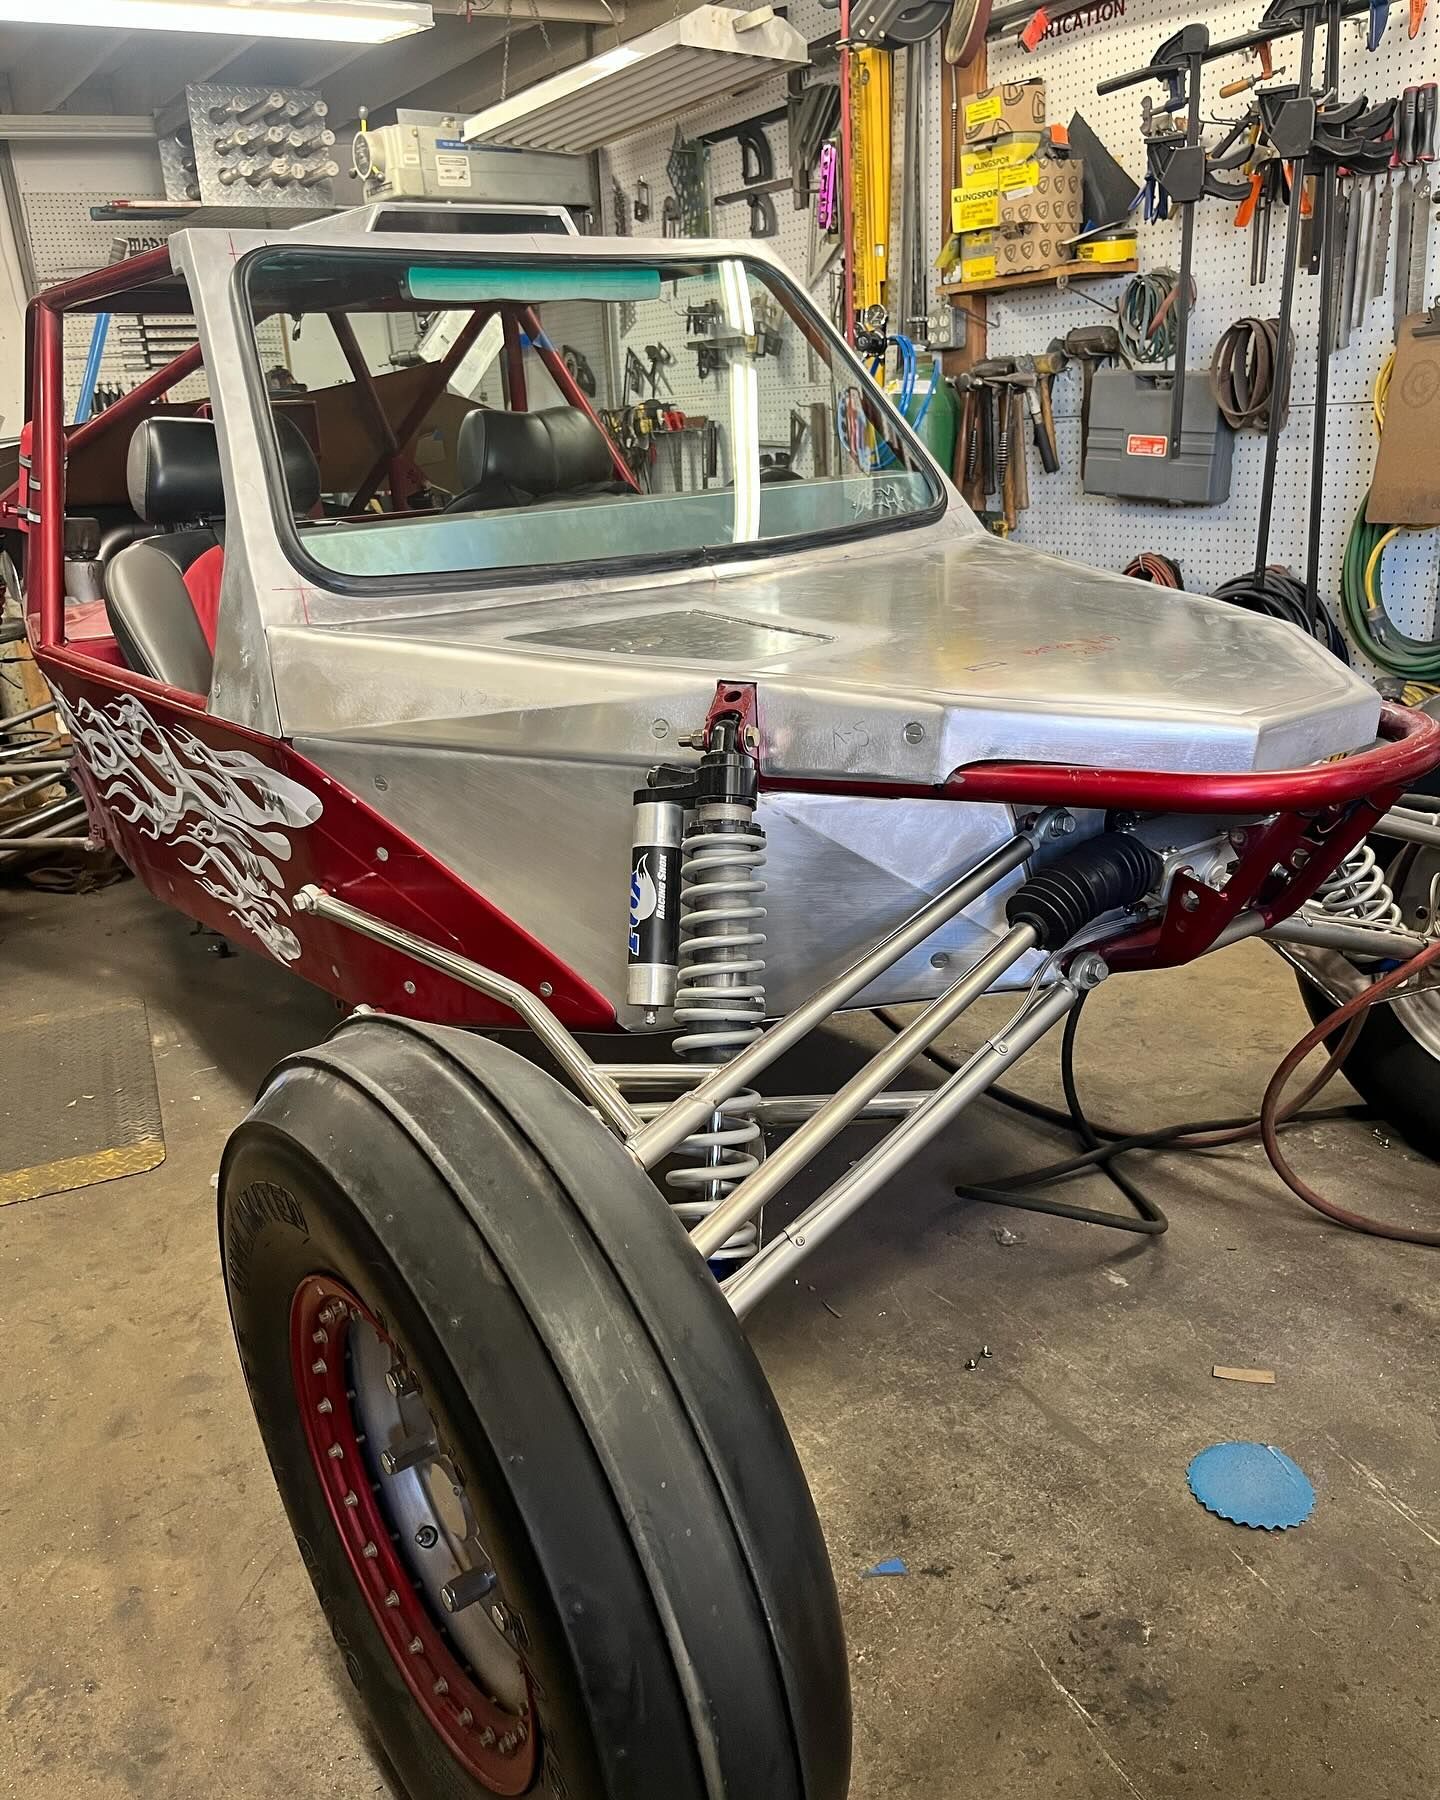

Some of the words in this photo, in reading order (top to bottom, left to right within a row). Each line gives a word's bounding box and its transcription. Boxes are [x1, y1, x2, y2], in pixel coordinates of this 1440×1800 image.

[954, 189, 998, 203] KLINGSPOR
[657, 853, 667, 881] SHOX
[656, 881, 667, 920] RACING
